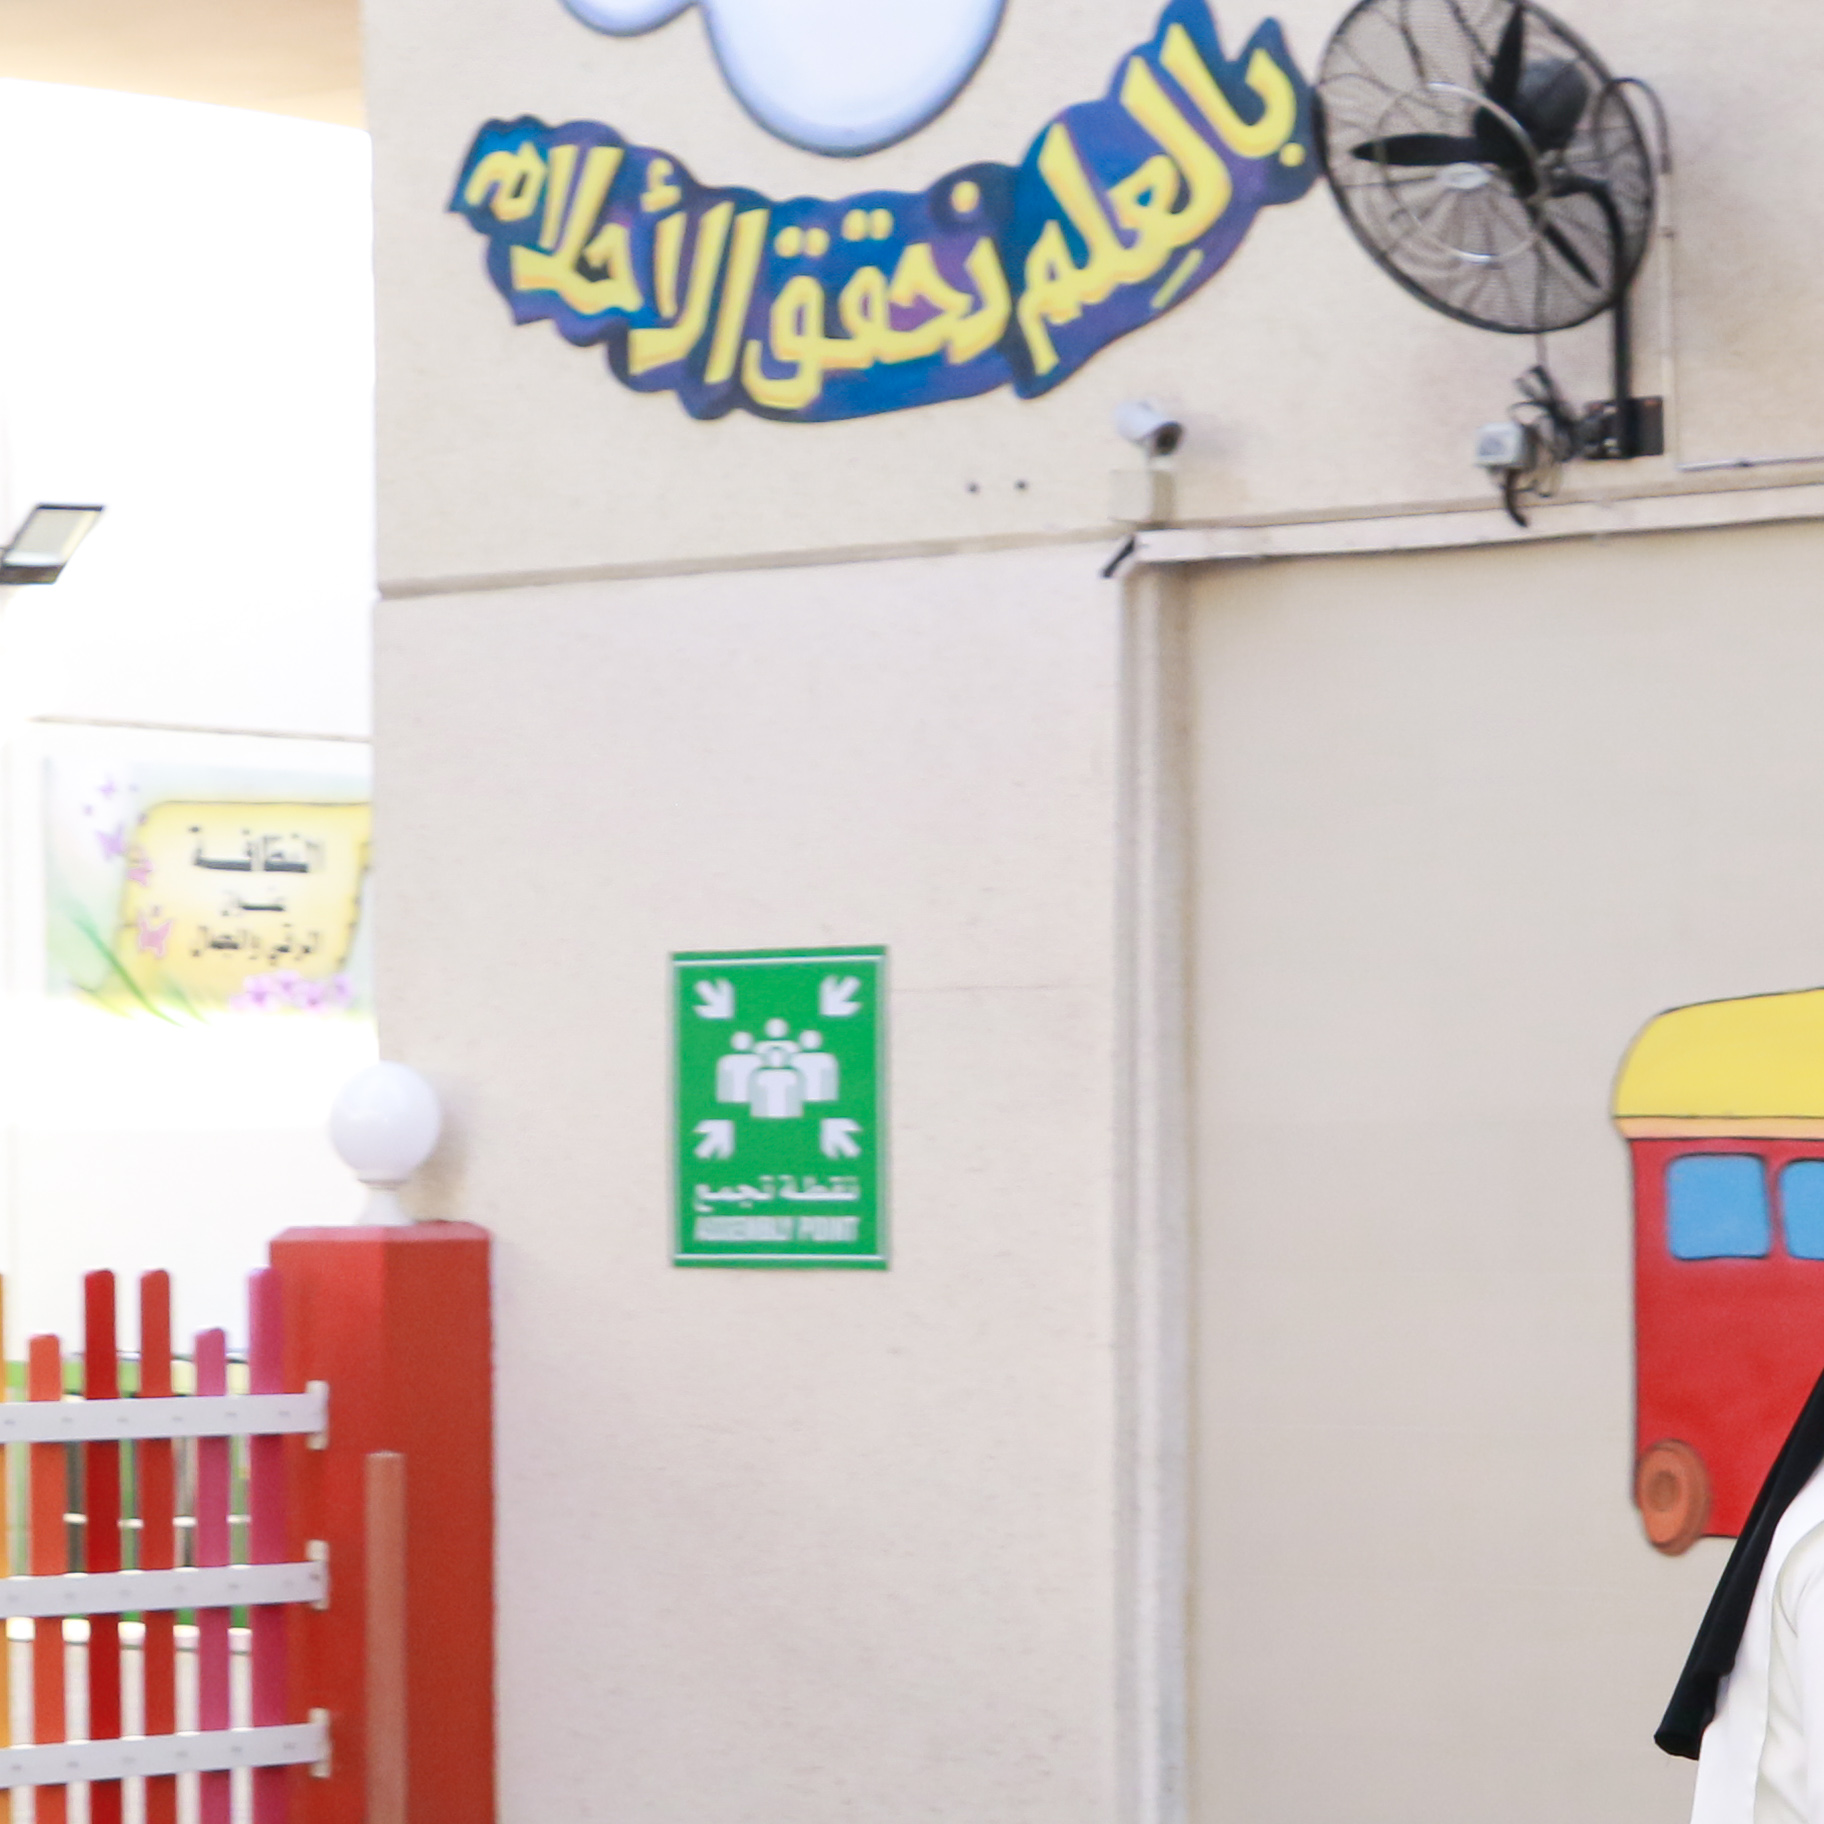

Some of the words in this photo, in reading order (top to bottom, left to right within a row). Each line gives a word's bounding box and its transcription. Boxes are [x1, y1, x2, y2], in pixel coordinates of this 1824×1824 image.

[463, 142, 770, 385] الأحلام
[187, 825, 324, 874] النظافة
[694, 1173, 776, 1213] تجمع
[779, 1173, 861, 1201] نقطة
